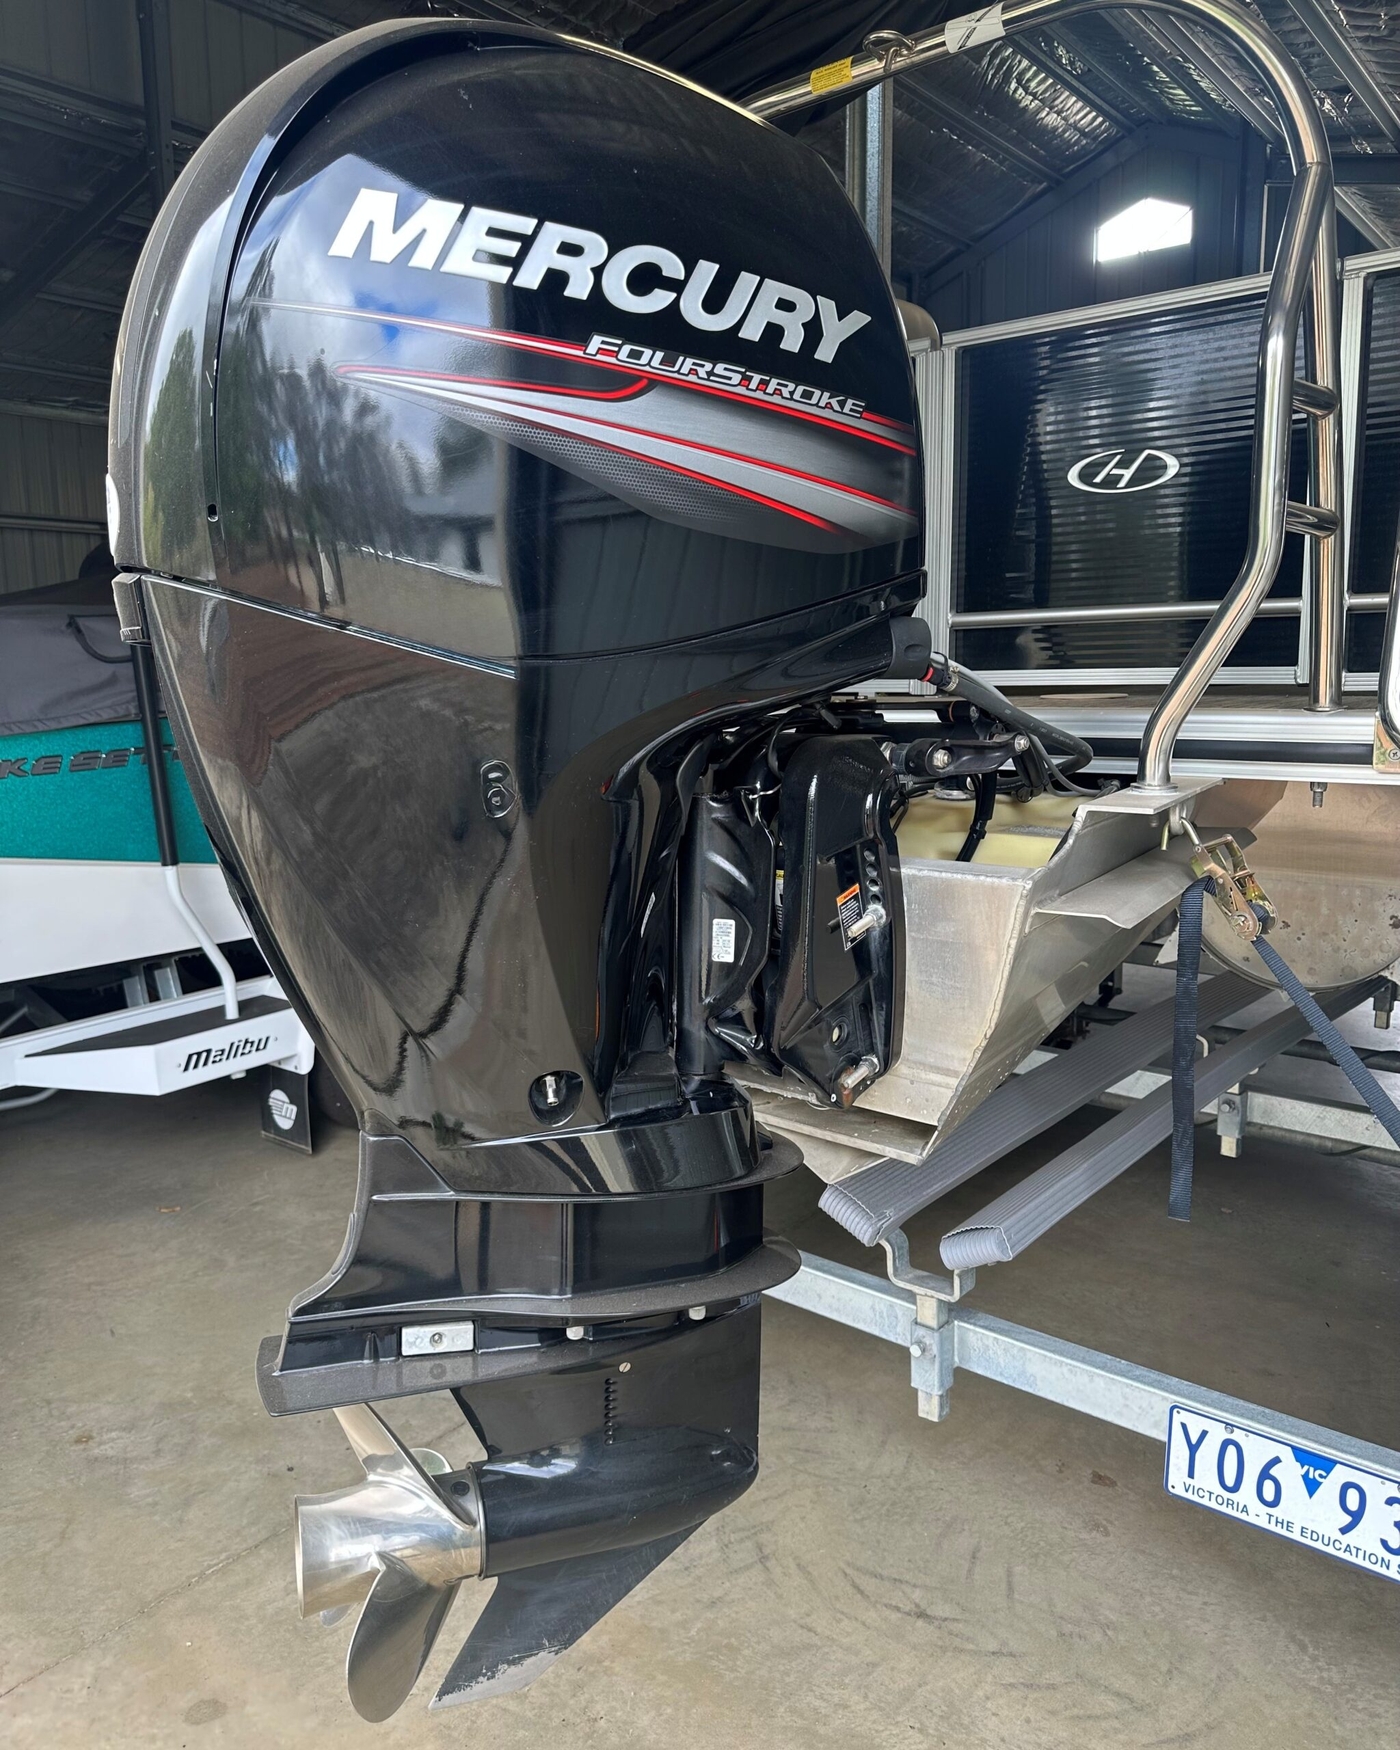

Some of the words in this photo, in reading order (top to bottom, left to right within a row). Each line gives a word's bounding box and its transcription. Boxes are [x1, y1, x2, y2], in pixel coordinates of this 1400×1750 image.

[327, 188, 871, 363] MERCURY
[183, 1036, 270, 1073] Malibu
[1180, 1421, 1283, 1509] Y06
[1300, 1464, 1328, 1483] VIC
[1183, 1481, 1250, 1517] VICTORIA
[1266, 1512, 1295, 1533] THE
[1300, 1526, 1391, 1571] EDUCATION
